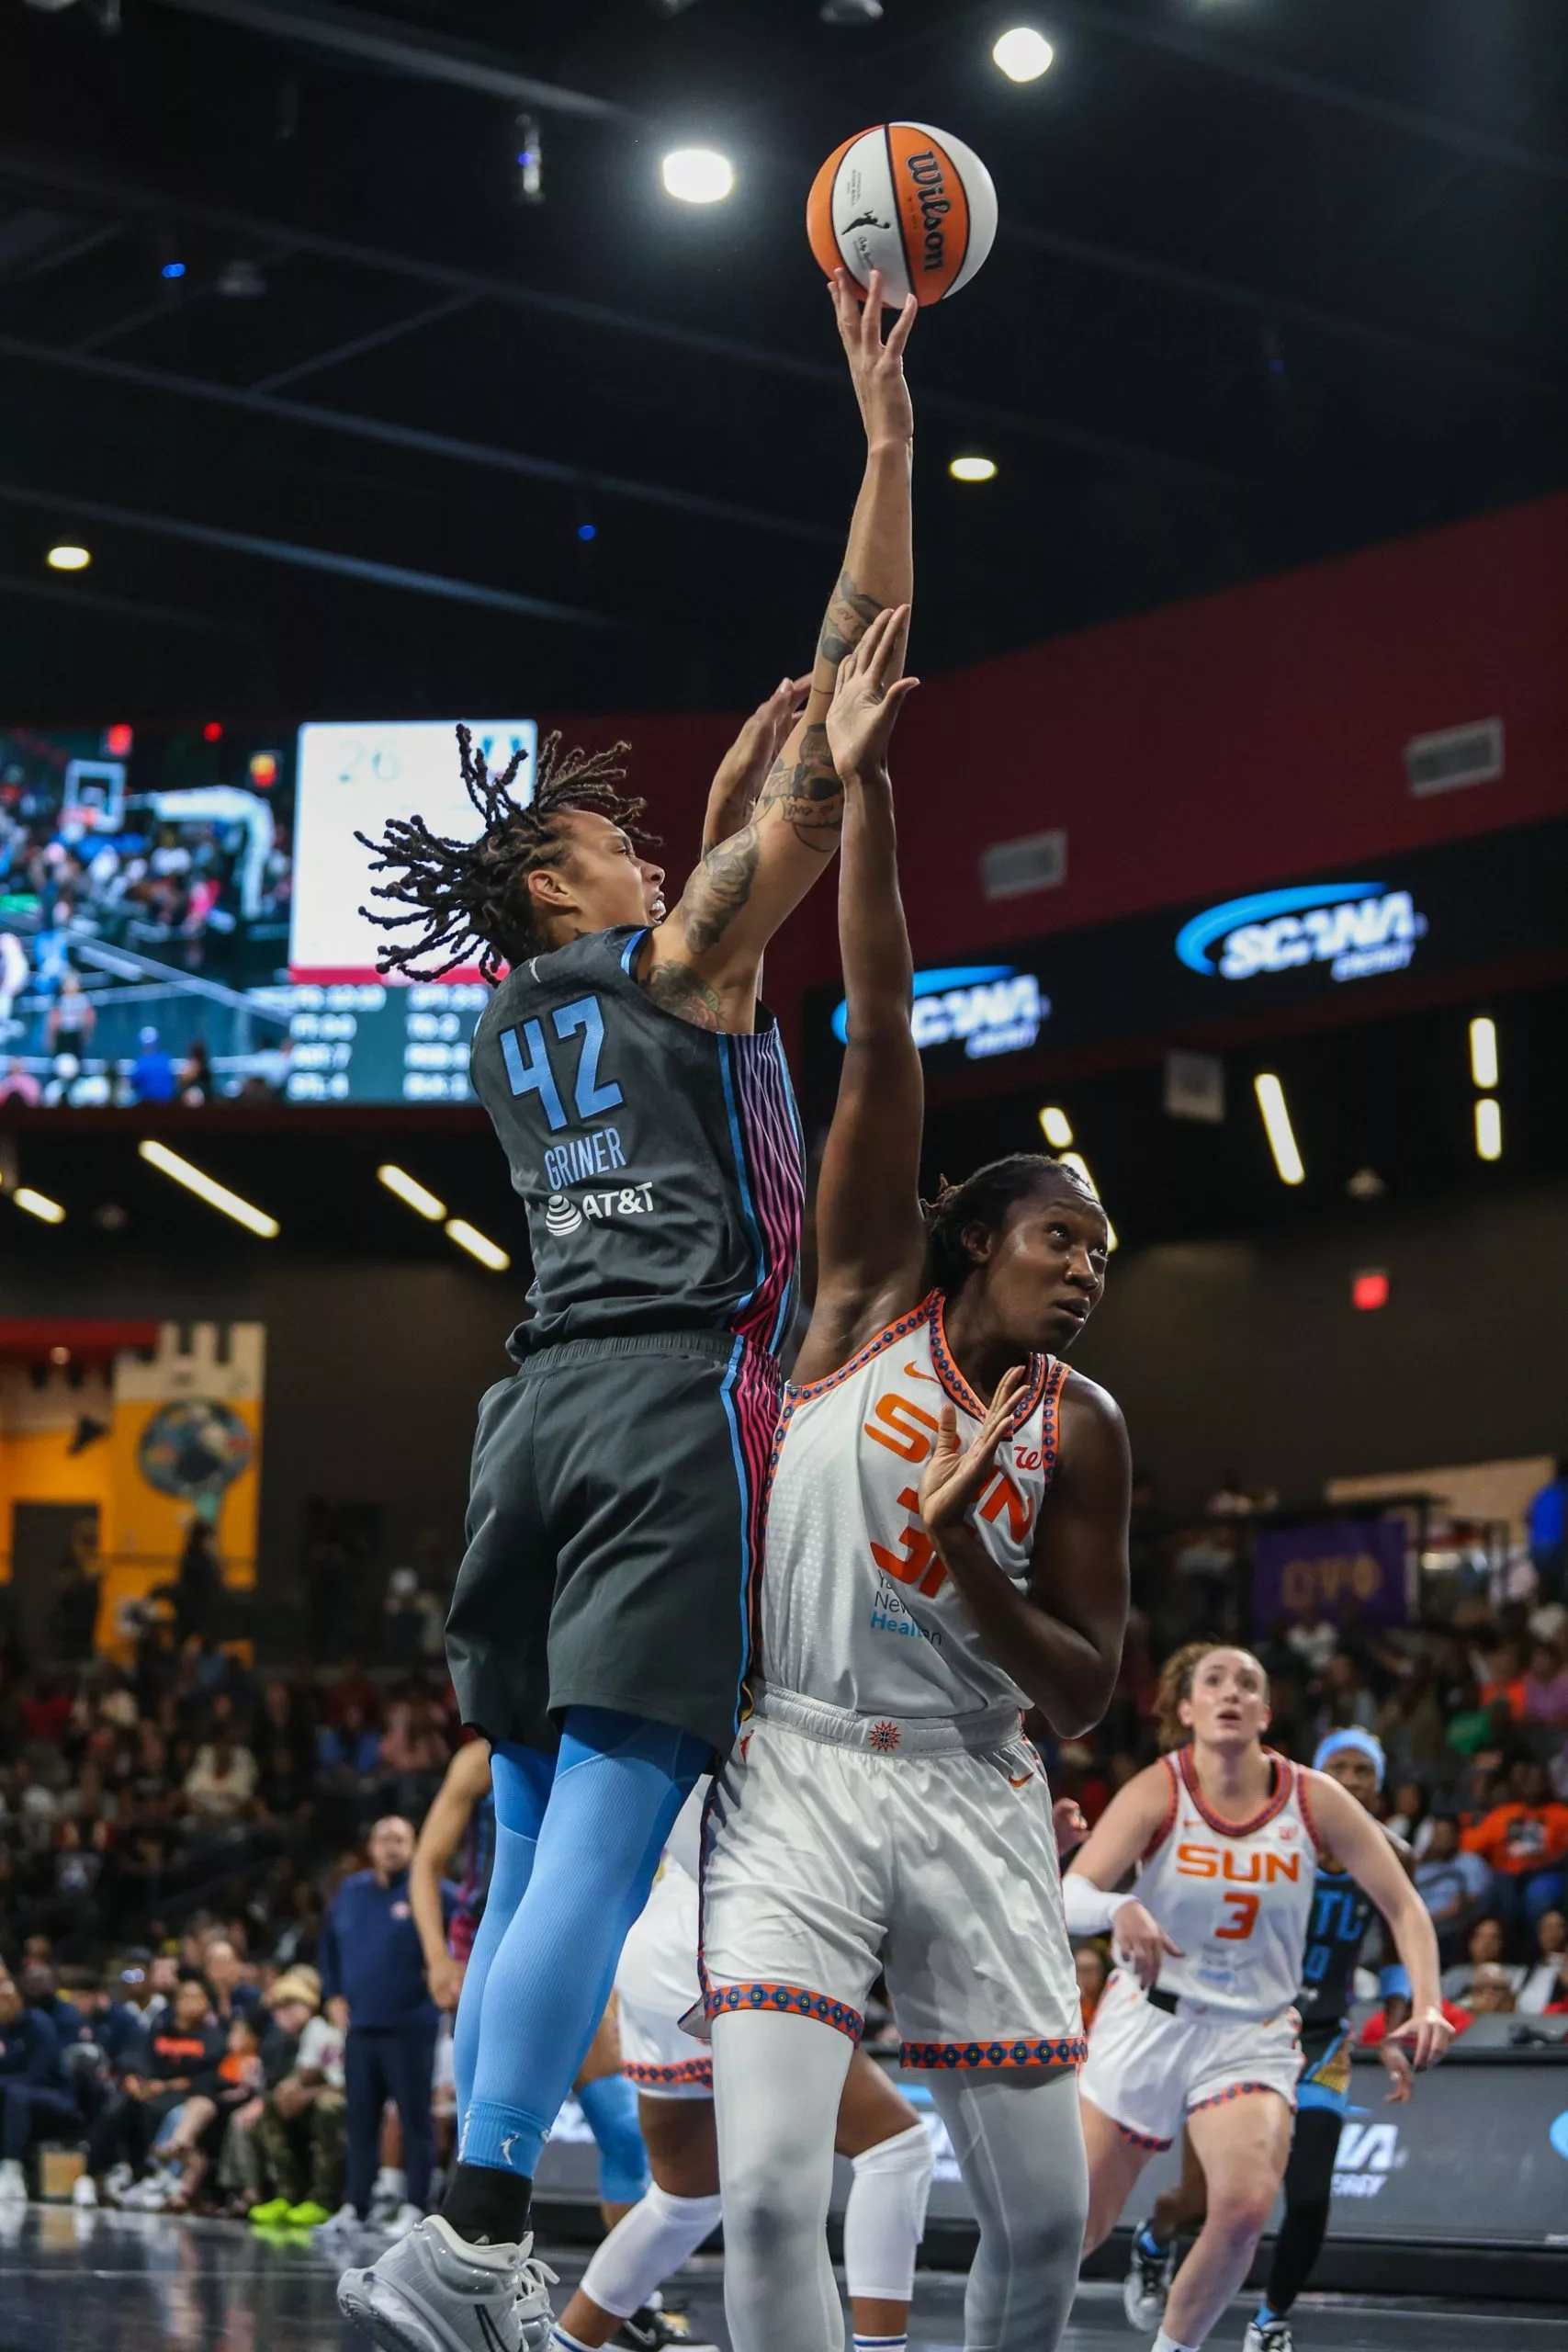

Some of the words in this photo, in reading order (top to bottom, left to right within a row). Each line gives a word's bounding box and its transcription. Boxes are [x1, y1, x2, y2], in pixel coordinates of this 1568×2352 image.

[906, 151, 952, 272] Wilson
[500, 995, 623, 1130] 42
[545, 1127, 626, 1191] GRINER
[582, 1182, 654, 1220] AT&T
[864, 1393, 1033, 1544] SN
[1177, 1843, 1301, 1883] SUN
[1214, 1892, 1260, 1940] 3
